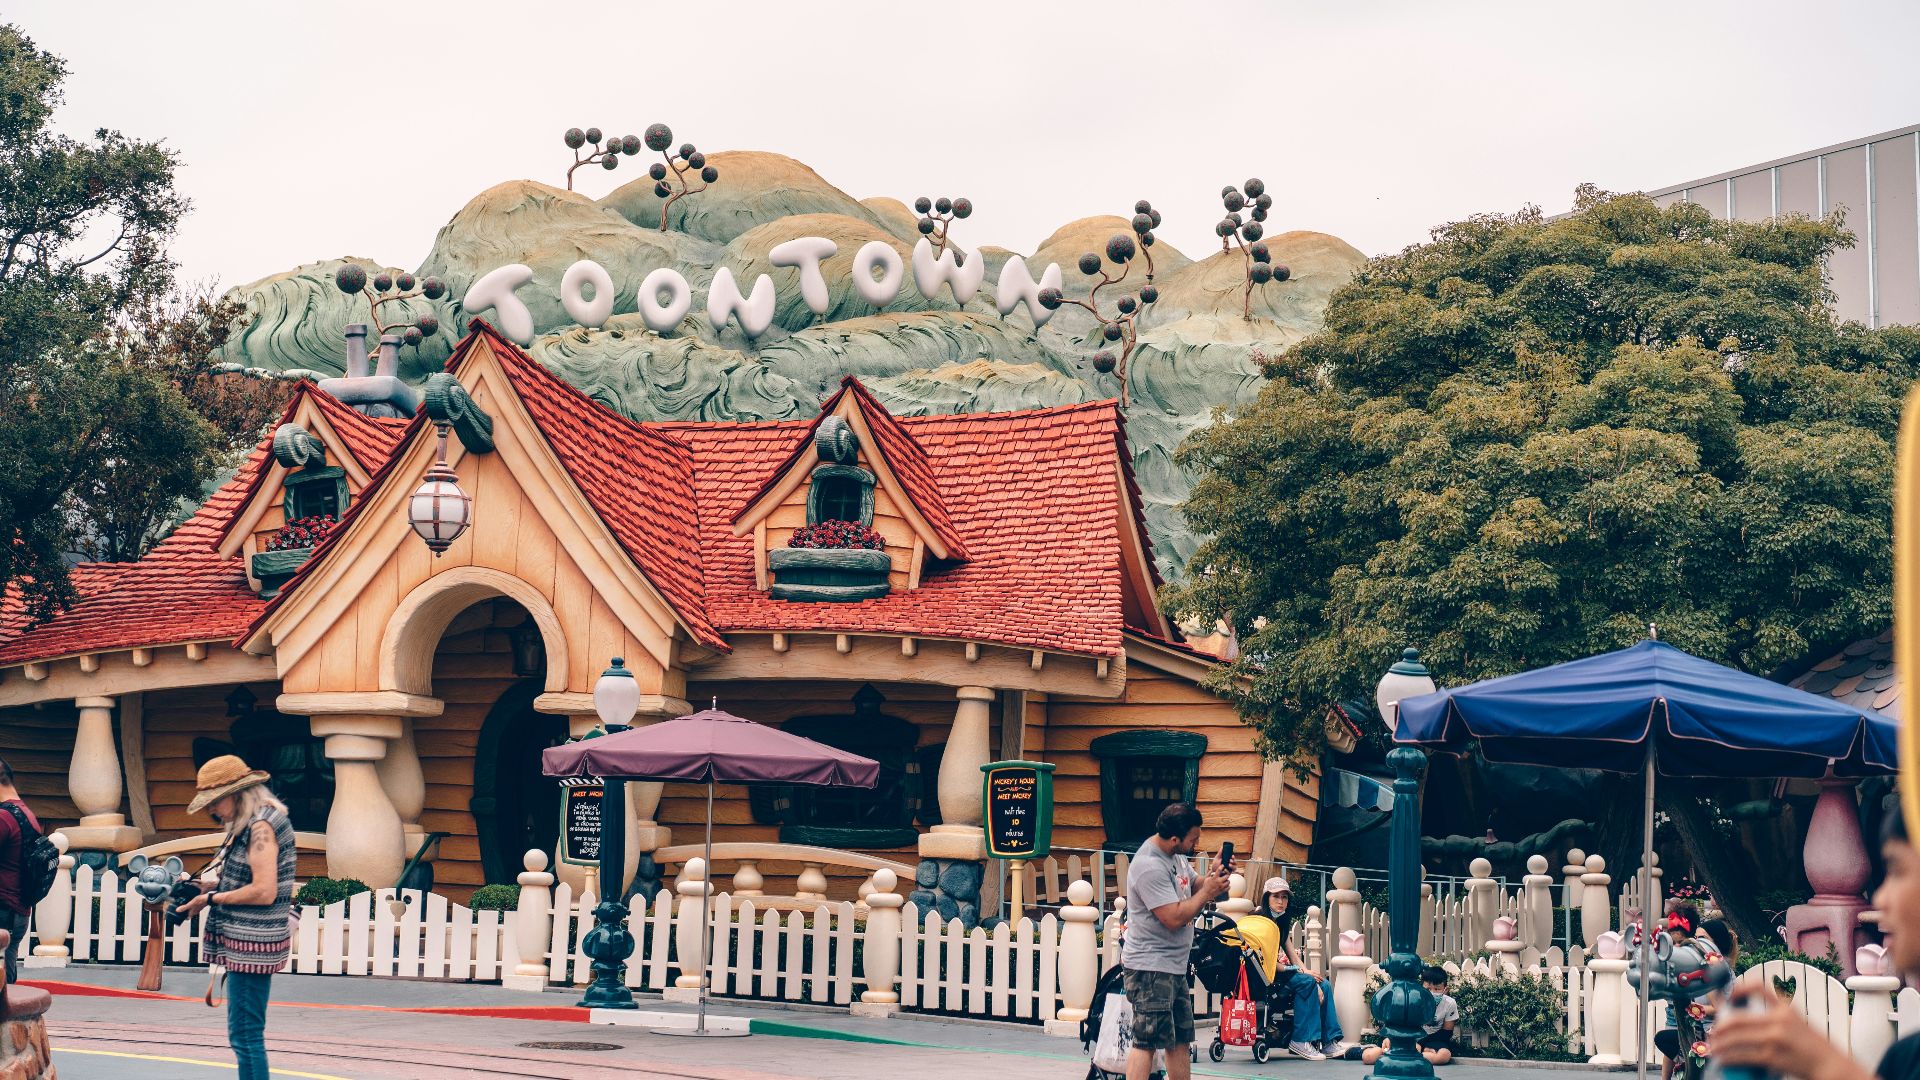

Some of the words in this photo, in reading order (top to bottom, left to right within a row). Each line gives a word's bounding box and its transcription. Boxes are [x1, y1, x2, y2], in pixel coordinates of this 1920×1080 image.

[463, 236, 1063, 346] TOONTOWN
[1012, 792, 1032, 800] MICKEY
[1011, 818, 1020, 826] 10
